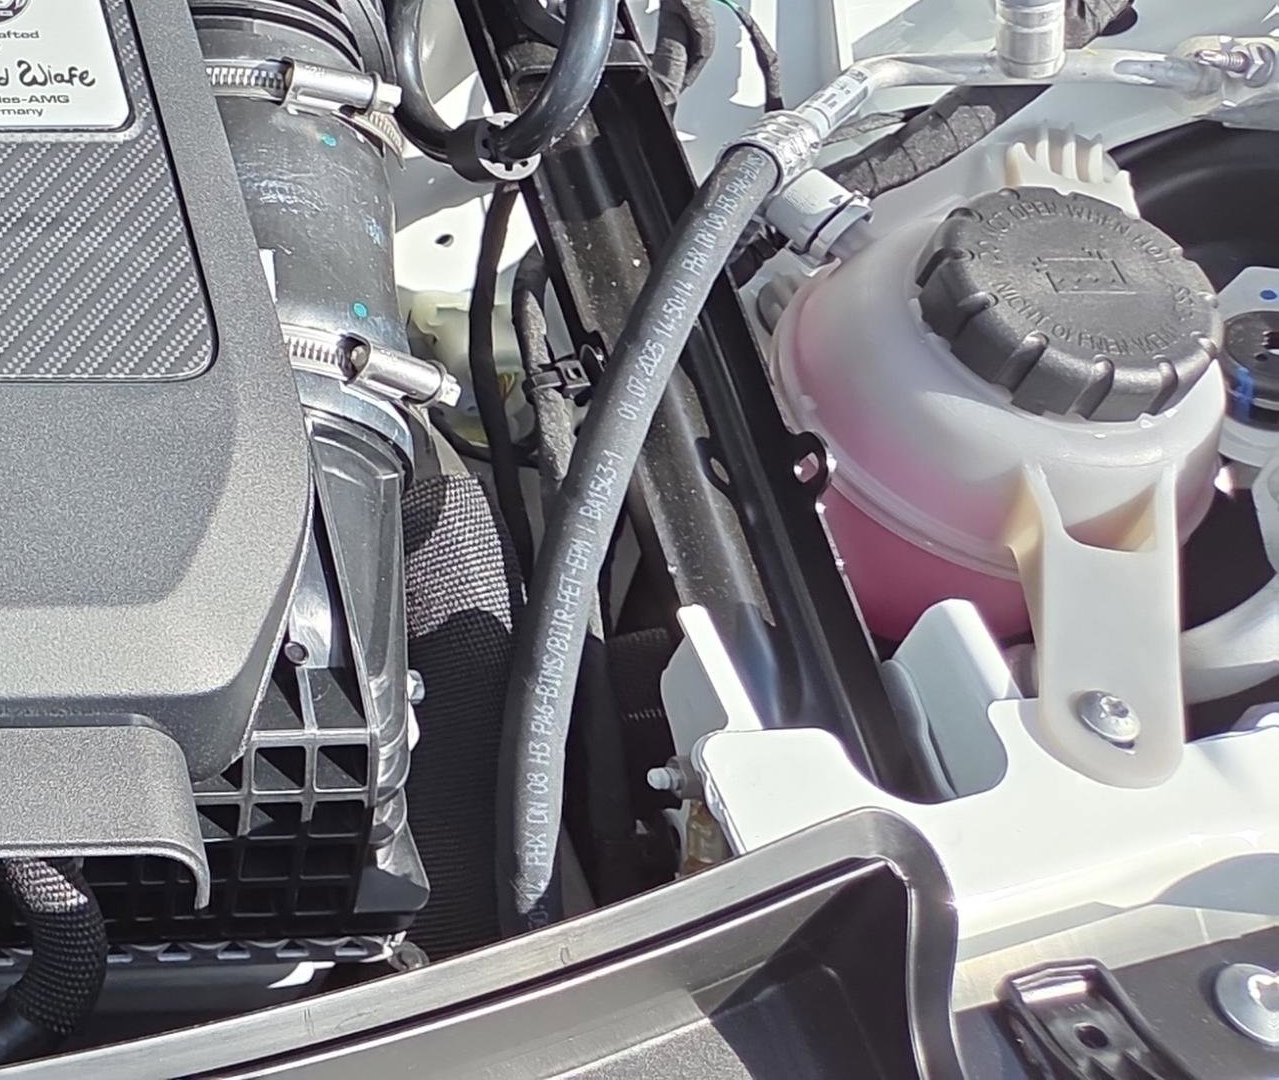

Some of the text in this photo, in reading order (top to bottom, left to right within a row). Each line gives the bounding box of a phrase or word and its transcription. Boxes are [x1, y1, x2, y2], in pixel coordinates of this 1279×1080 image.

[682, 245, 711, 276] PHX
[653, 278, 696, 339] 14:50:14
[615, 338, 666, 422] 01.07.2025
[527, 740, 552, 765] H3
[525, 771, 551, 795] 08
